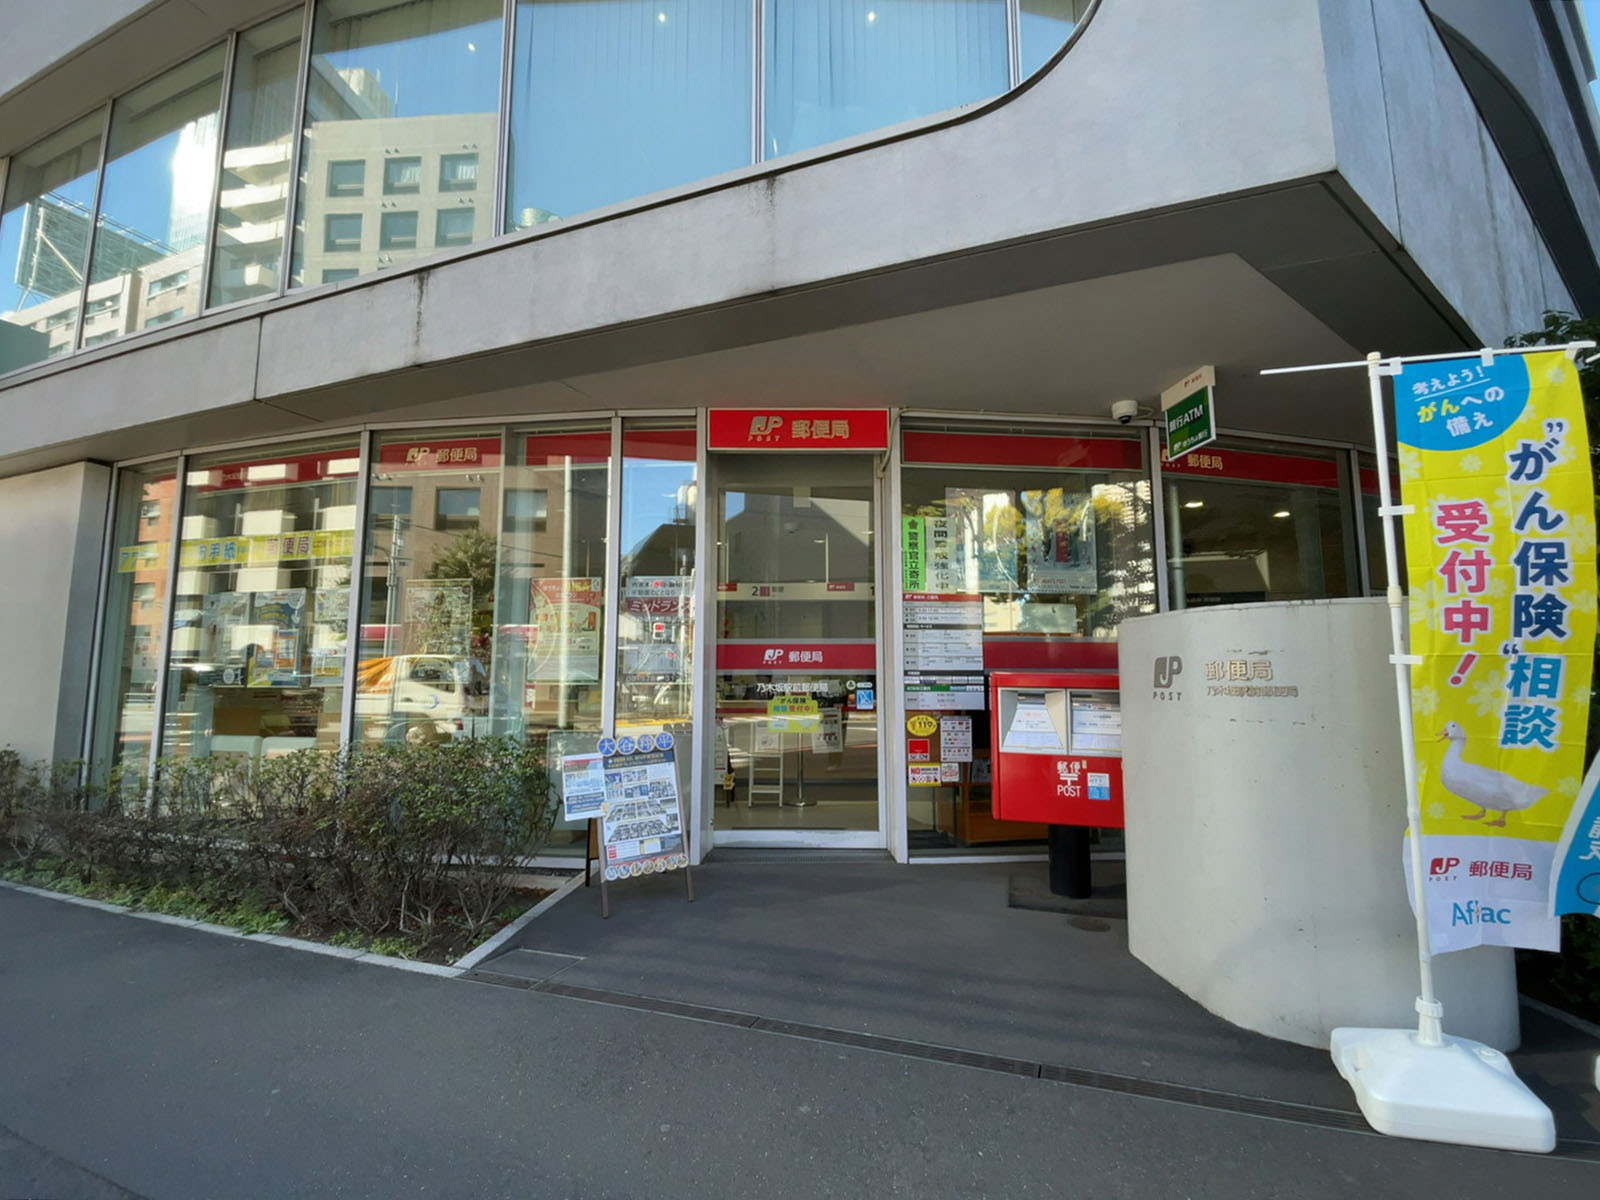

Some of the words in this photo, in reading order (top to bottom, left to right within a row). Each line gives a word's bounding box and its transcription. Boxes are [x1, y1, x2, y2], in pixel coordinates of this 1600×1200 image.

[1417, 386, 1505, 423] がんへの
[791, 420, 850, 439] 郵便局
[1446, 411, 1494, 437] 備え
[435, 447, 478, 463] 郵便局
[1187, 453, 1224, 470] 郵便局
[751, 586, 759, 596] 2
[1436, 500, 1492, 686] 受付中!
[788, 651, 824, 663] 郵便局
[1204, 660, 1274, 682] 郵便局
[1153, 691, 1182, 701] POST
[1057, 760, 1081, 775] 郵便
[1057, 785, 1082, 797] POST
[1469, 860, 1533, 880] 郵便局
